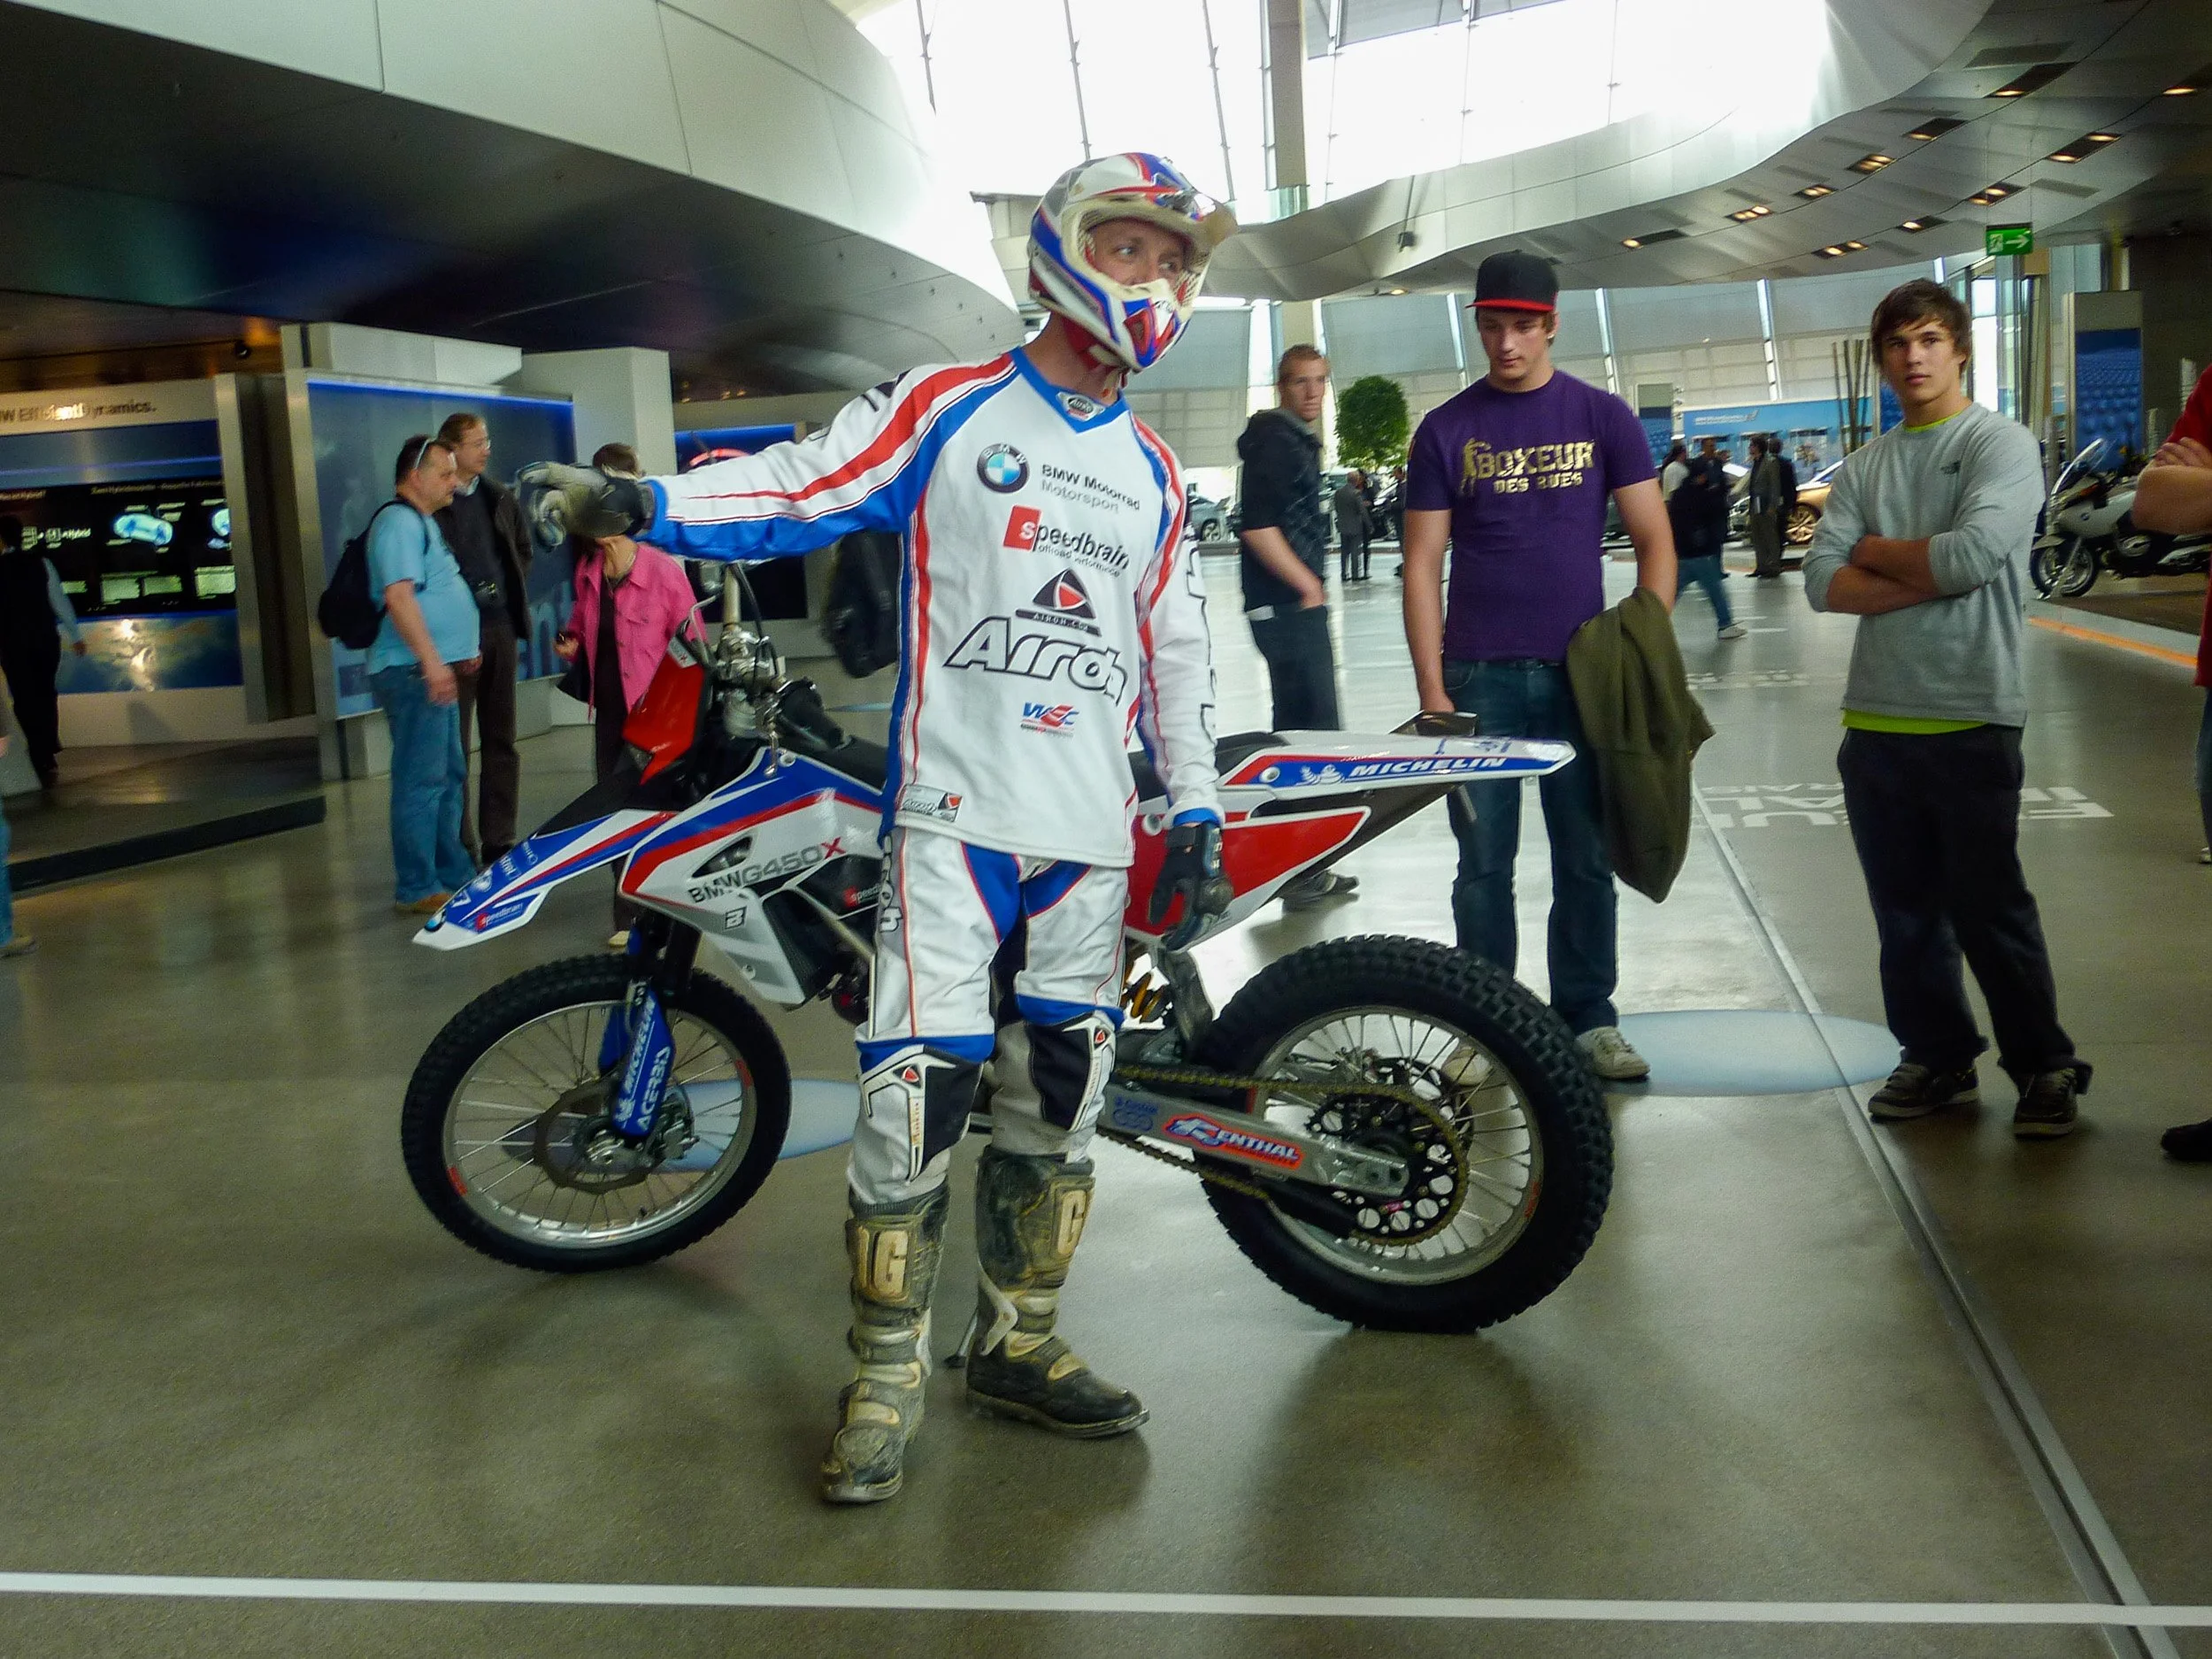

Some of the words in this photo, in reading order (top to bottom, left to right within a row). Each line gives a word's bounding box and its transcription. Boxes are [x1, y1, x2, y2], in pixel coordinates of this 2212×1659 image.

[1477, 441, 1594, 479] BOXEUR
[1042, 464, 1080, 484] BMW
[1085, 475, 1141, 511] Motorrad
[1493, 477, 1530, 494] DES
[1019, 520, 1130, 570] speedbrain
[1348, 757, 1508, 778] MICHELIN
